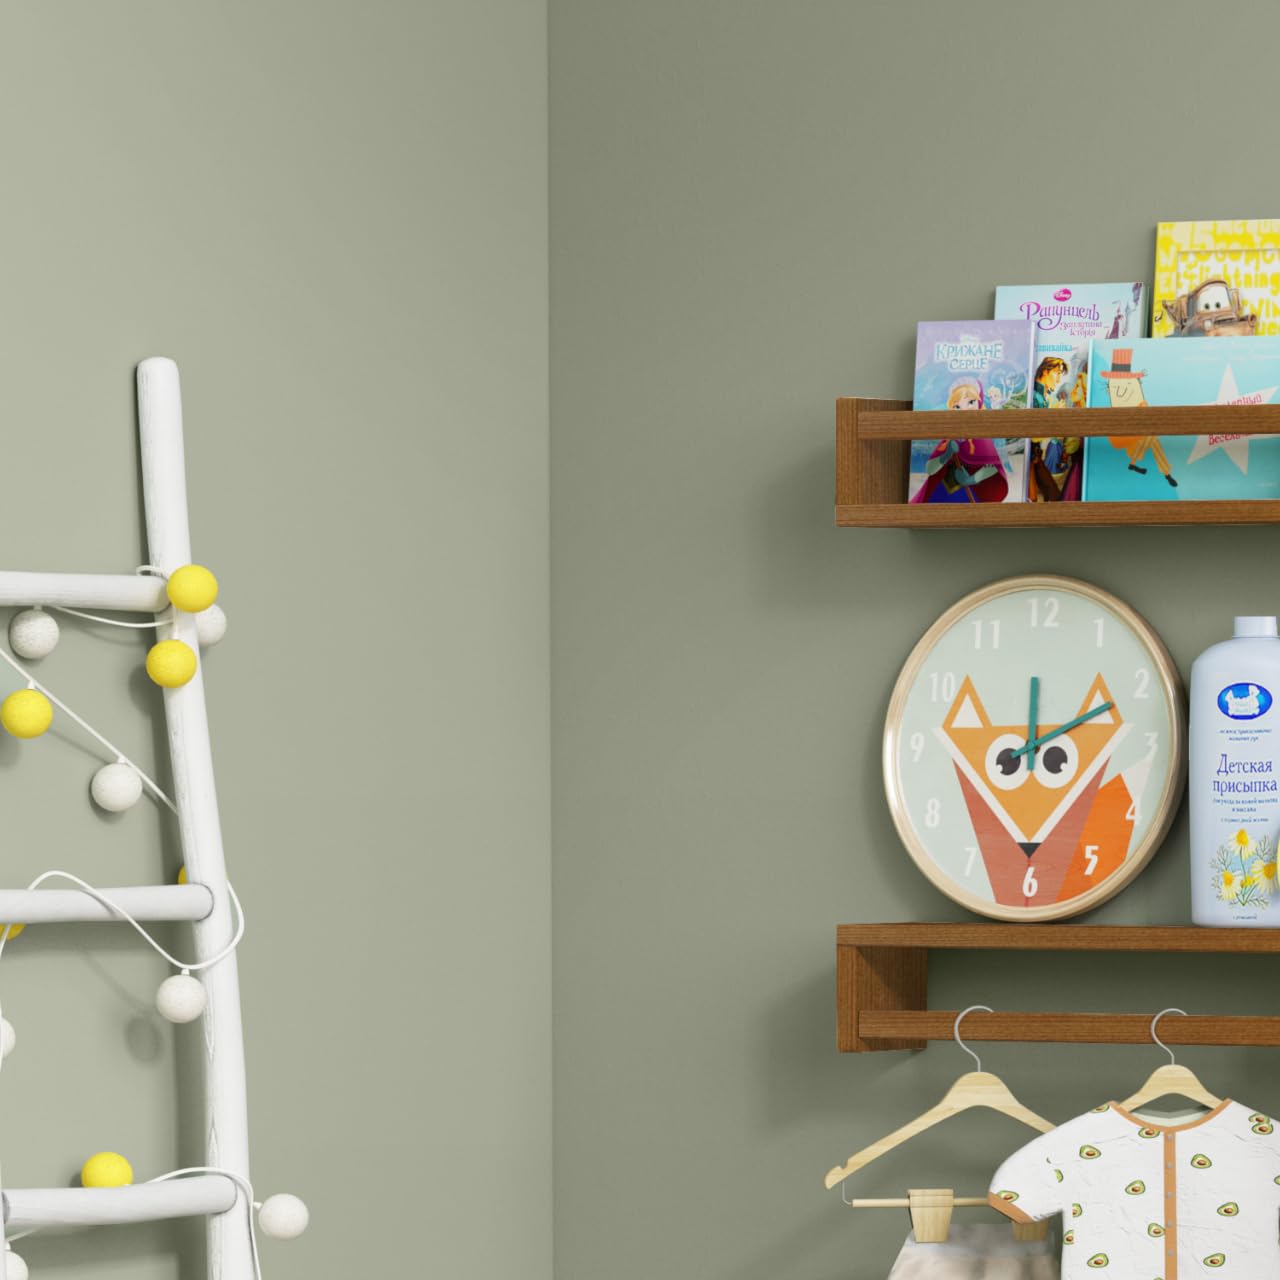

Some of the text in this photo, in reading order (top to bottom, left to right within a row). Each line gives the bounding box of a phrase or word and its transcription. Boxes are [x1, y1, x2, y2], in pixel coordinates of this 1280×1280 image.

[1019, 301, 1100, 331] Рапунцель
[936, 343, 1002, 360] КРИЖАНЕ
[949, 358, 989, 370] СЕРЦЕ
[1027, 599, 1060, 628] 12
[971, 620, 1001, 649] 11
[1093, 618, 1105, 648] 1
[929, 672, 956, 702] 10
[1134, 668, 1150, 699] 2
[910, 733, 925, 762] 9
[1144, 732, 1159, 755] 3
[1216, 753, 1273, 776] Детская
[1212, 779, 1278, 797] присыпка
[925, 799, 941, 828] 8
[1125, 796, 1141, 825] 4
[964, 848, 978, 877] 7
[1084, 845, 1100, 876] 5
[1022, 866, 1039, 898] 6
